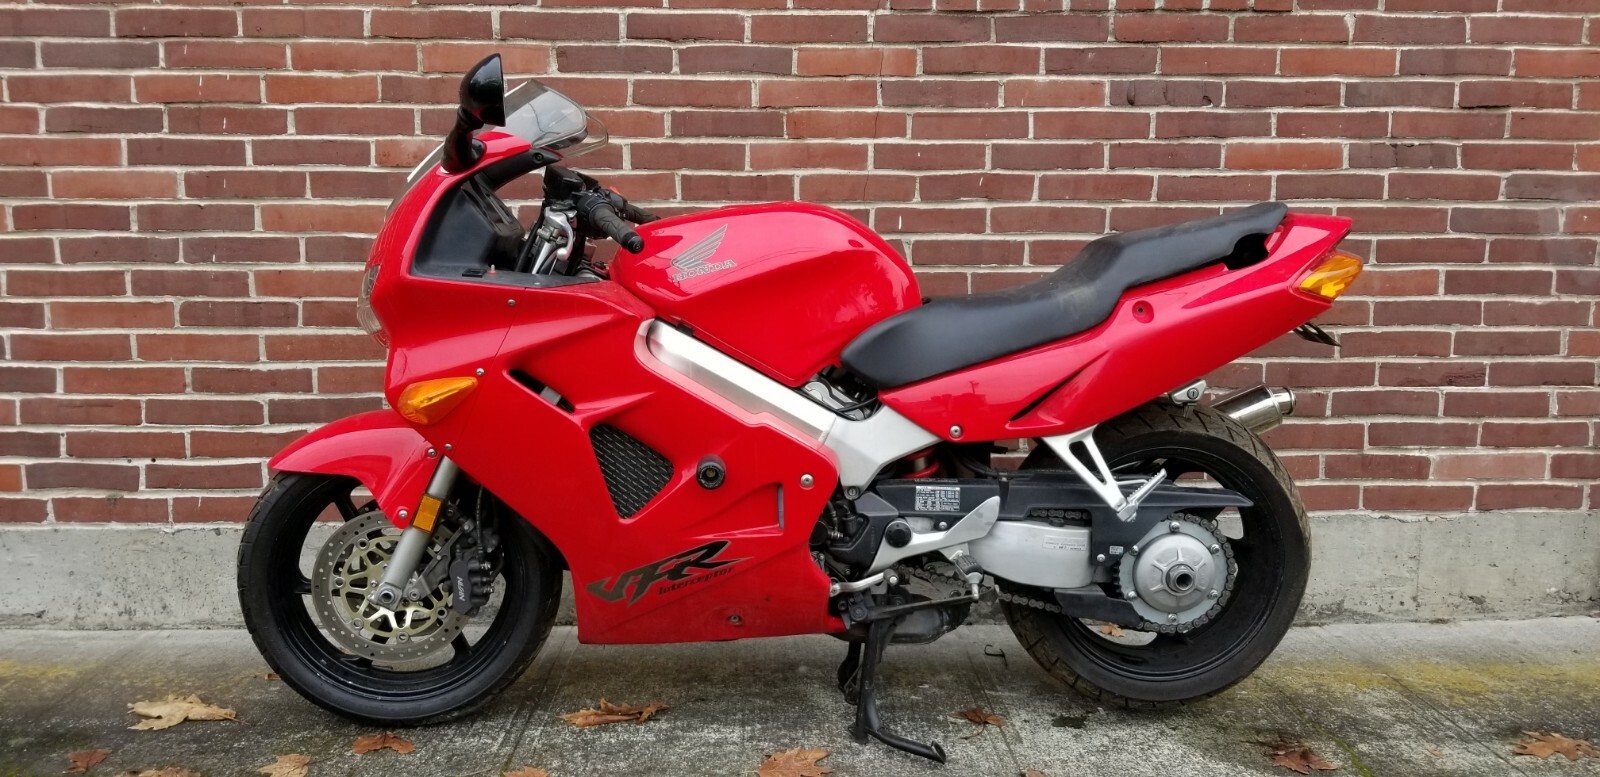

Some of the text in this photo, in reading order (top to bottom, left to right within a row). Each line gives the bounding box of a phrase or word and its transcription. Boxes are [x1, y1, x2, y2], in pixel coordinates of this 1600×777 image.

[672, 260, 737, 282] HONDA
[586, 540, 752, 608] VFR
[658, 567, 734, 596] Interceptor
